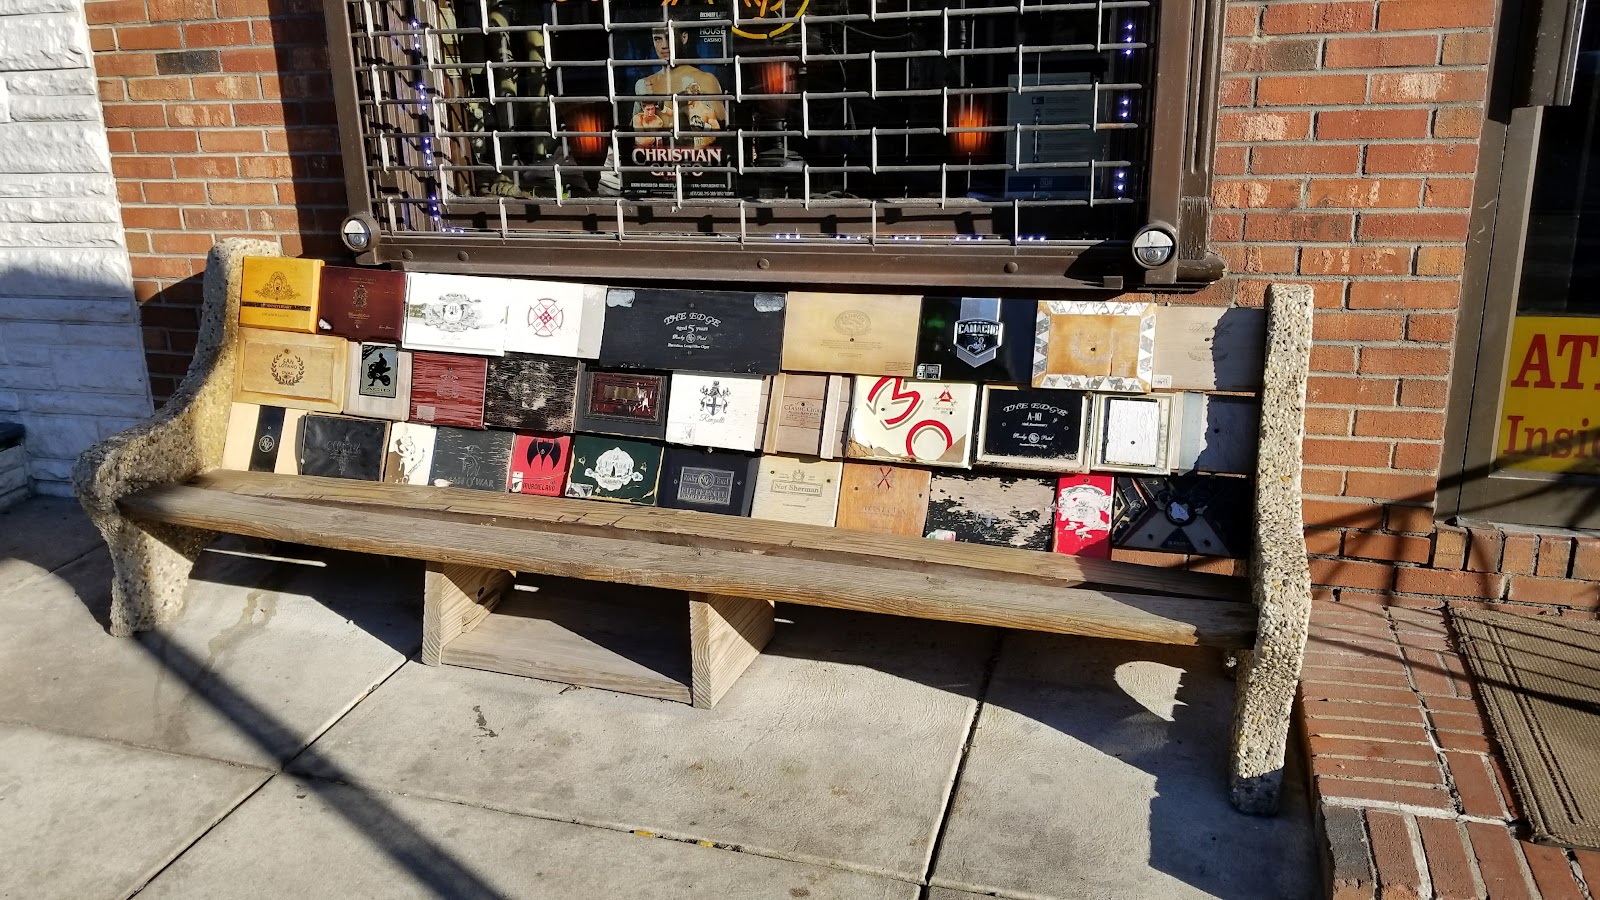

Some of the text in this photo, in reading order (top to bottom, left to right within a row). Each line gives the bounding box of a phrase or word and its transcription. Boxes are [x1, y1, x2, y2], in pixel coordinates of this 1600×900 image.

[700, 27, 726, 35] HOUSE
[631, 148, 722, 166] CHRISTIAN
[664, 312, 721, 327] THE EDGE
[688, 324, 695, 333] 5
[958, 324, 999, 336] CAMACHO
[1511, 333, 1600, 390] AT
[1003, 403, 1068, 416] THE EDGE
[1027, 412, 1042, 421] A-10
[789, 484, 819, 493] Sherman
